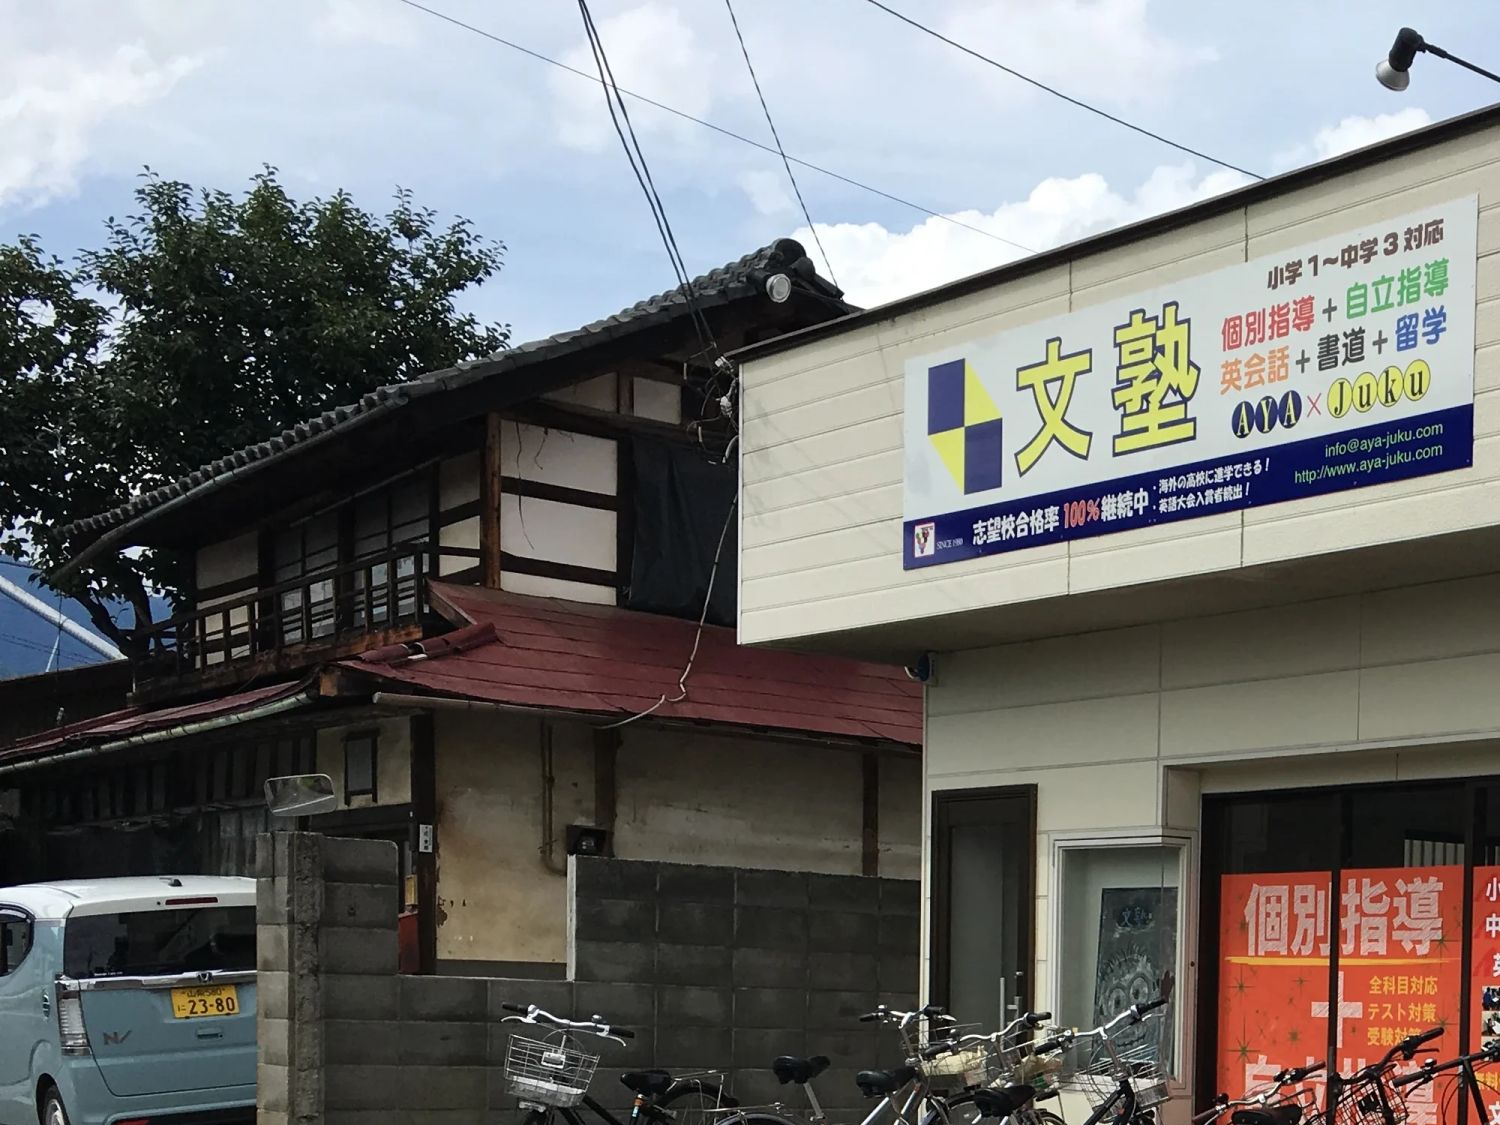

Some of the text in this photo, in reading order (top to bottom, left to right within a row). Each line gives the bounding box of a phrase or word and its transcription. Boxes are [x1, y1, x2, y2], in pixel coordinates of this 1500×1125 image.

[1014, 300, 1201, 478] 文塾
[1234, 391, 1298, 437] AYA
[1332, 364, 1425, 416] Juku
[1325, 422, 1443, 458] info@aya-juku.com
[1294, 443, 1443, 484] http://www.aya-juku.com
[1244, 876, 1444, 957] 個別指導
[1369, 975, 1438, 995] 全科目対応
[188, 997, 235, 1015] 23-80
[1368, 1002, 1436, 1022] テスト対策
